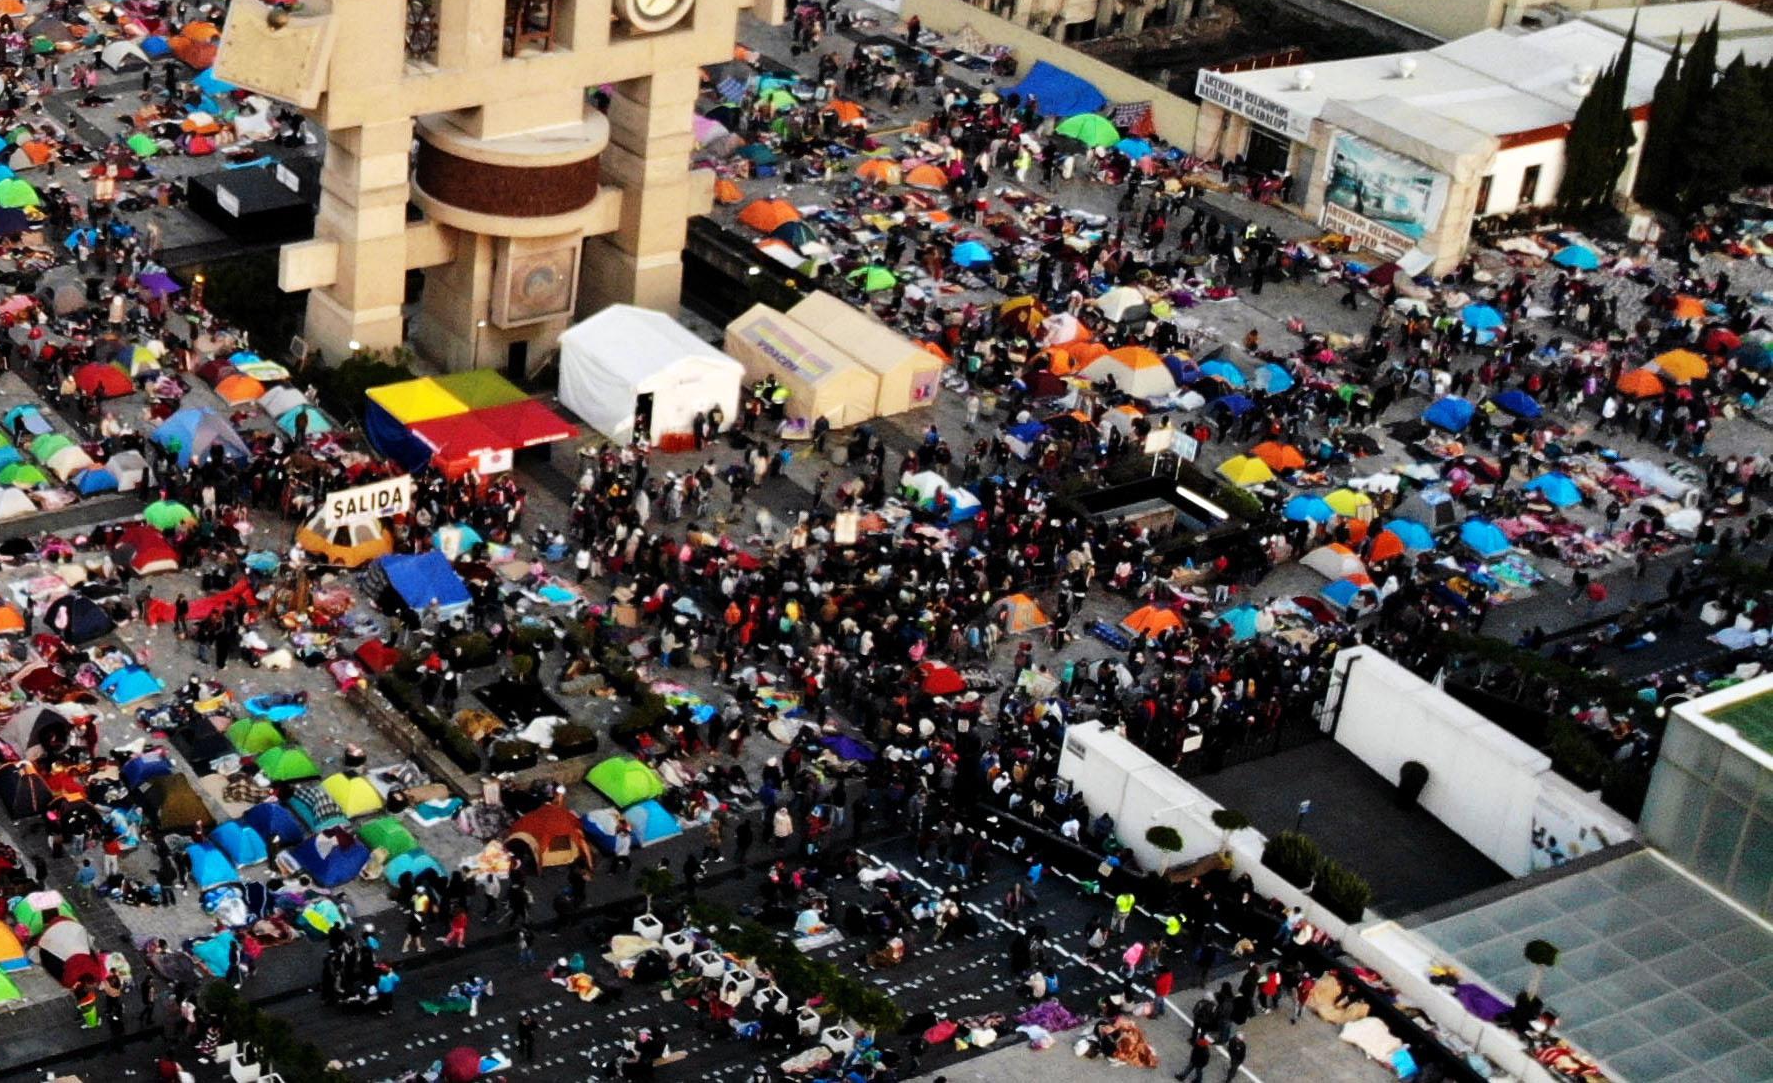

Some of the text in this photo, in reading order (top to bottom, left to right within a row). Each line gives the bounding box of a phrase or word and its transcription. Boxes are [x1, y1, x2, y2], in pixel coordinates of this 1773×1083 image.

[1204, 73, 1290, 118] ARTICULOS RELIGIOSOS
[1233, 99, 1243, 112] DE
[334, 486, 403, 519] SALIDA
